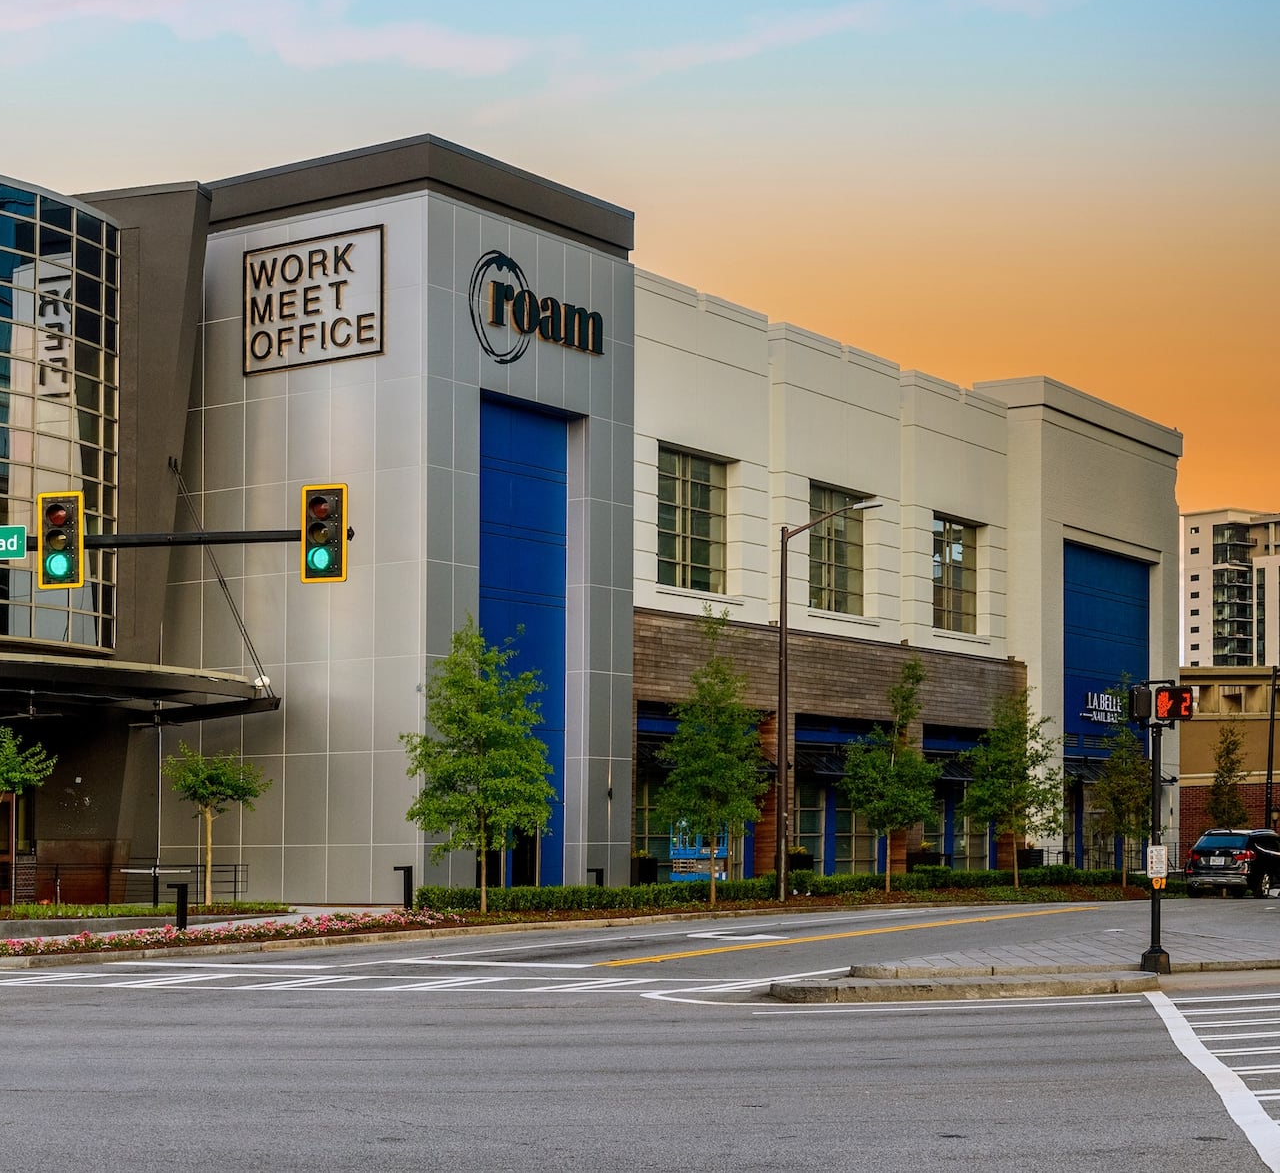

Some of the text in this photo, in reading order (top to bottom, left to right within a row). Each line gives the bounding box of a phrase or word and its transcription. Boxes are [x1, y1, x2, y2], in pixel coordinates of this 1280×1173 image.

[249, 243, 354, 290] WORK
[250, 280, 348, 326] MEET
[488, 280, 605, 356] roam
[251, 312, 376, 360] OFFICE
